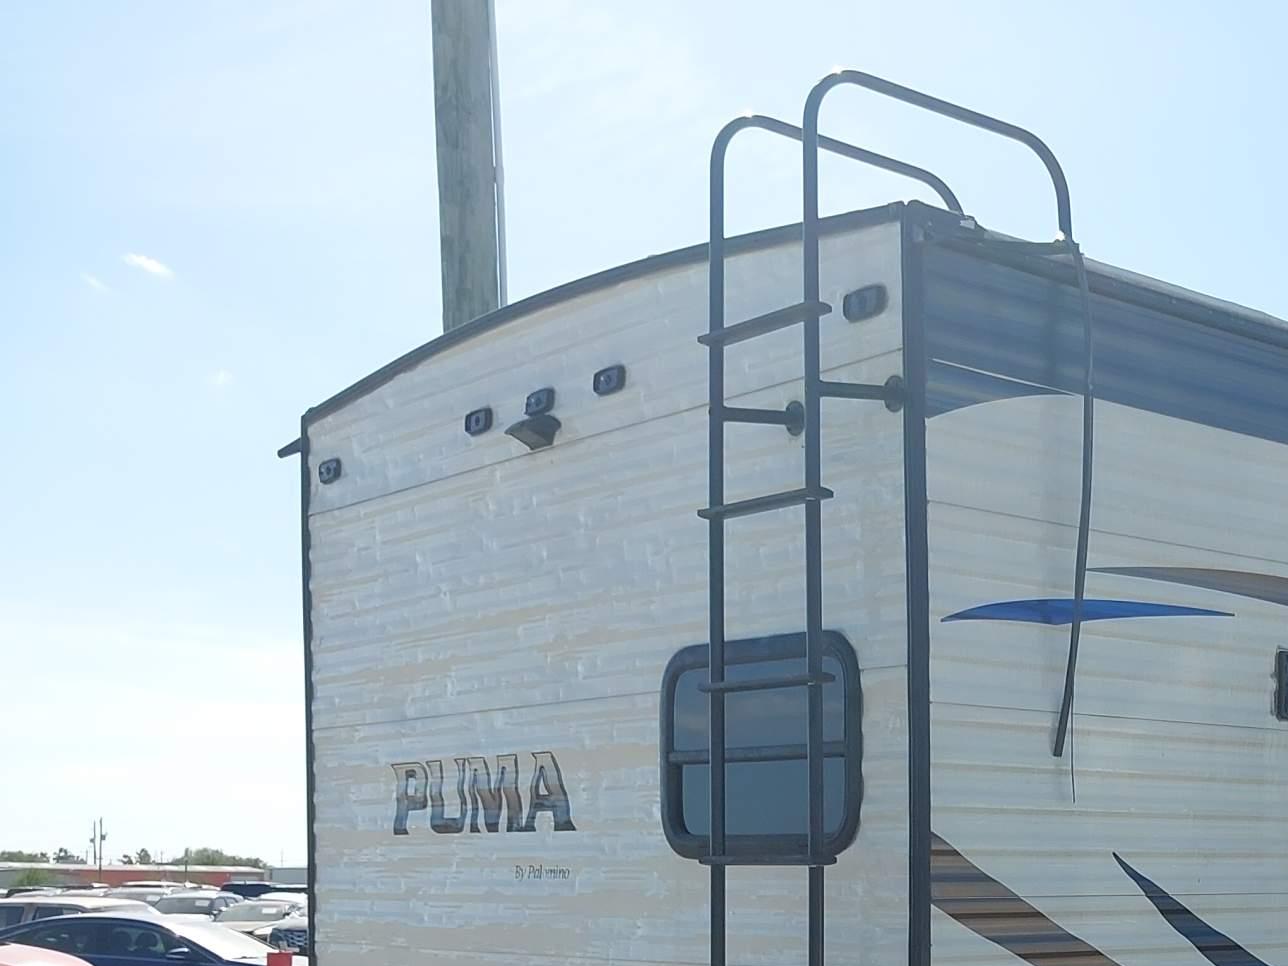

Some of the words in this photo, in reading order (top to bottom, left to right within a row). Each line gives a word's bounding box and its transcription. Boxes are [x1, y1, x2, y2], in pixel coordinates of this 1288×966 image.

[390, 751, 577, 836] PUMA
[514, 865, 526, 881] By
[527, 864, 570, 880] Palmino
